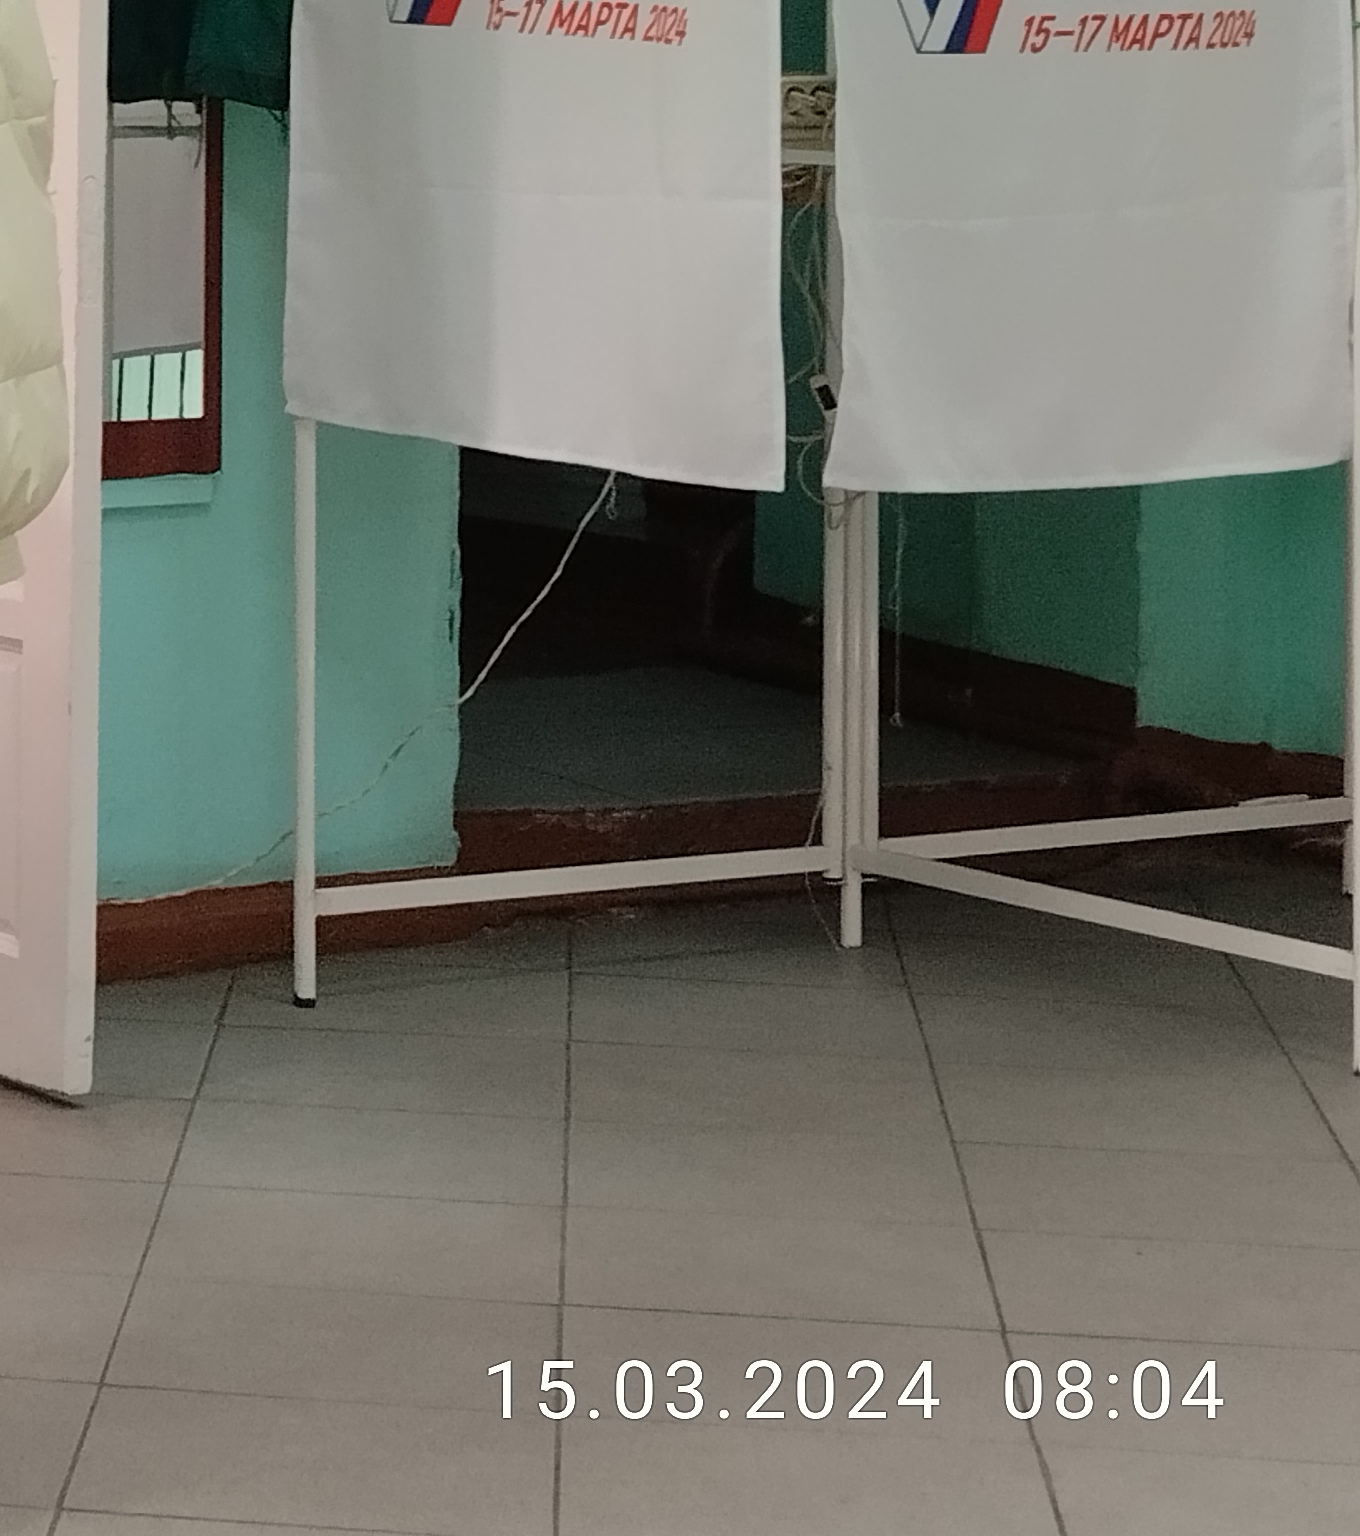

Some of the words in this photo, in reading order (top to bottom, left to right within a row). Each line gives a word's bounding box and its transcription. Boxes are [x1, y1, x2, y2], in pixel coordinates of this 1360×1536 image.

[546, 0, 639, 41] МАРТА
[642, 4, 688, 46] 2024
[1106, 12, 1205, 52] МАРТА
[1206, 10, 1256, 50] 2024
